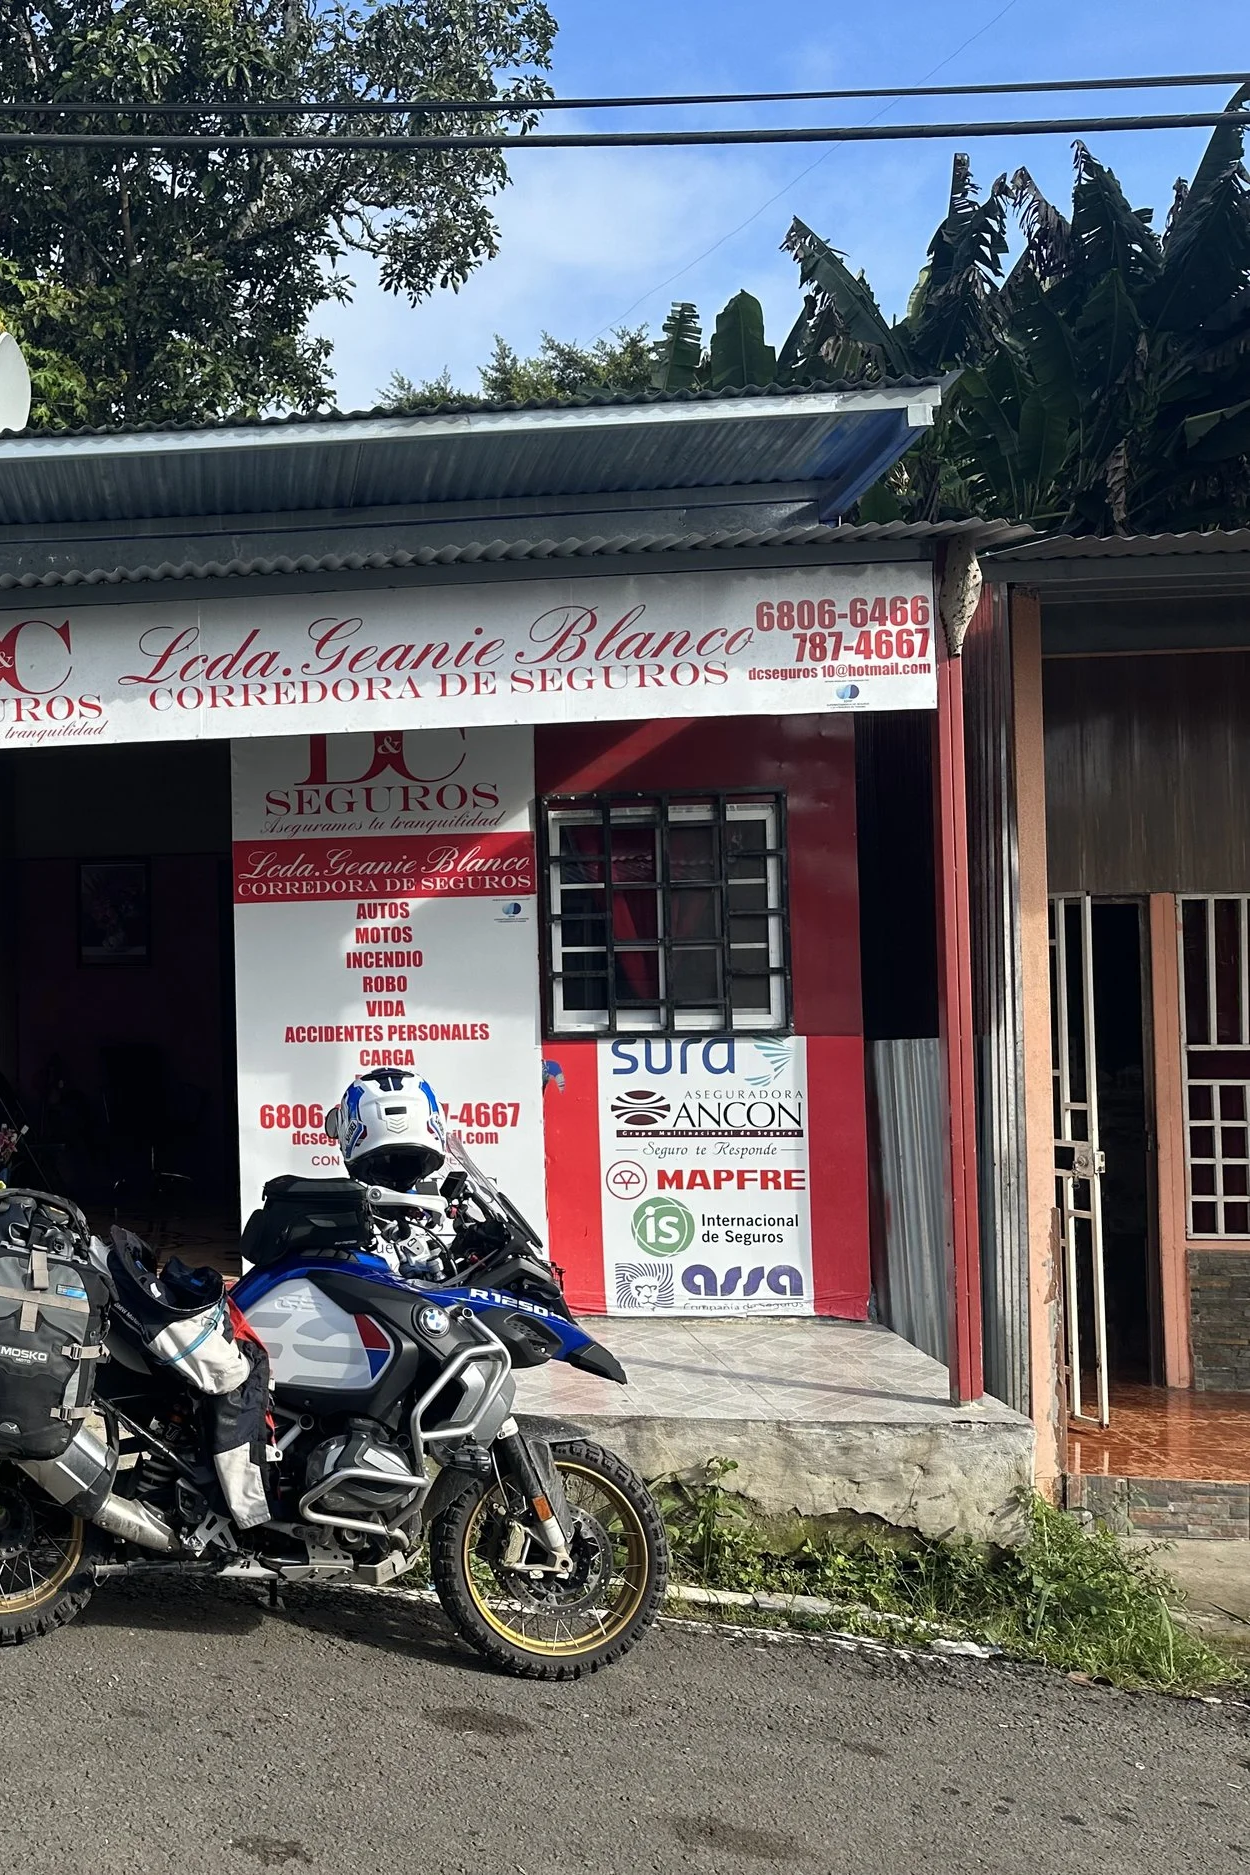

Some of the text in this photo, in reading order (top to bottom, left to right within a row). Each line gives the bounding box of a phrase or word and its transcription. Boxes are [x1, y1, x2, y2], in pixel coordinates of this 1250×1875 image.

[756, 595, 930, 632] 6806-6466
[515, 604, 755, 665] Blanco
[792, 628, 930, 662] 787-4667
[149, 661, 729, 712] CORREDORA DE SEGUROS
[4, 720, 108, 746] tranquilidad
[265, 782, 499, 816] SEGUROS
[261, 810, 506, 838] Aseguramos tu tranquilidad
[421, 845, 530, 873] Blanco
[238, 874, 530, 896] CORREDORA DE SEGUROS
[356, 902, 410, 919] AUTOS
[355, 927, 413, 944] MOTOS
[346, 951, 423, 968] INCENDIO
[363, 975, 407, 993] ROBO
[366, 1000, 405, 1017] VIDA
[285, 1023, 489, 1043] ACCIDENTES PERSONALES
[359, 1049, 415, 1066] CARGA
[611, 1037, 735, 1075] sura
[684, 1089, 804, 1099] ASEGURADORA
[672, 1101, 802, 1128] ANCON
[643, 1142, 778, 1159] Seguro te Responde
[311, 1156, 340, 1166] CON
[657, 1169, 806, 1190] MAPFRE
[702, 1213, 799, 1228] Internacional
[702, 1231, 784, 1245] de Seguros
[681, 1264, 804, 1296] assa
[0, 1346, 47, 1361] MOSKO
